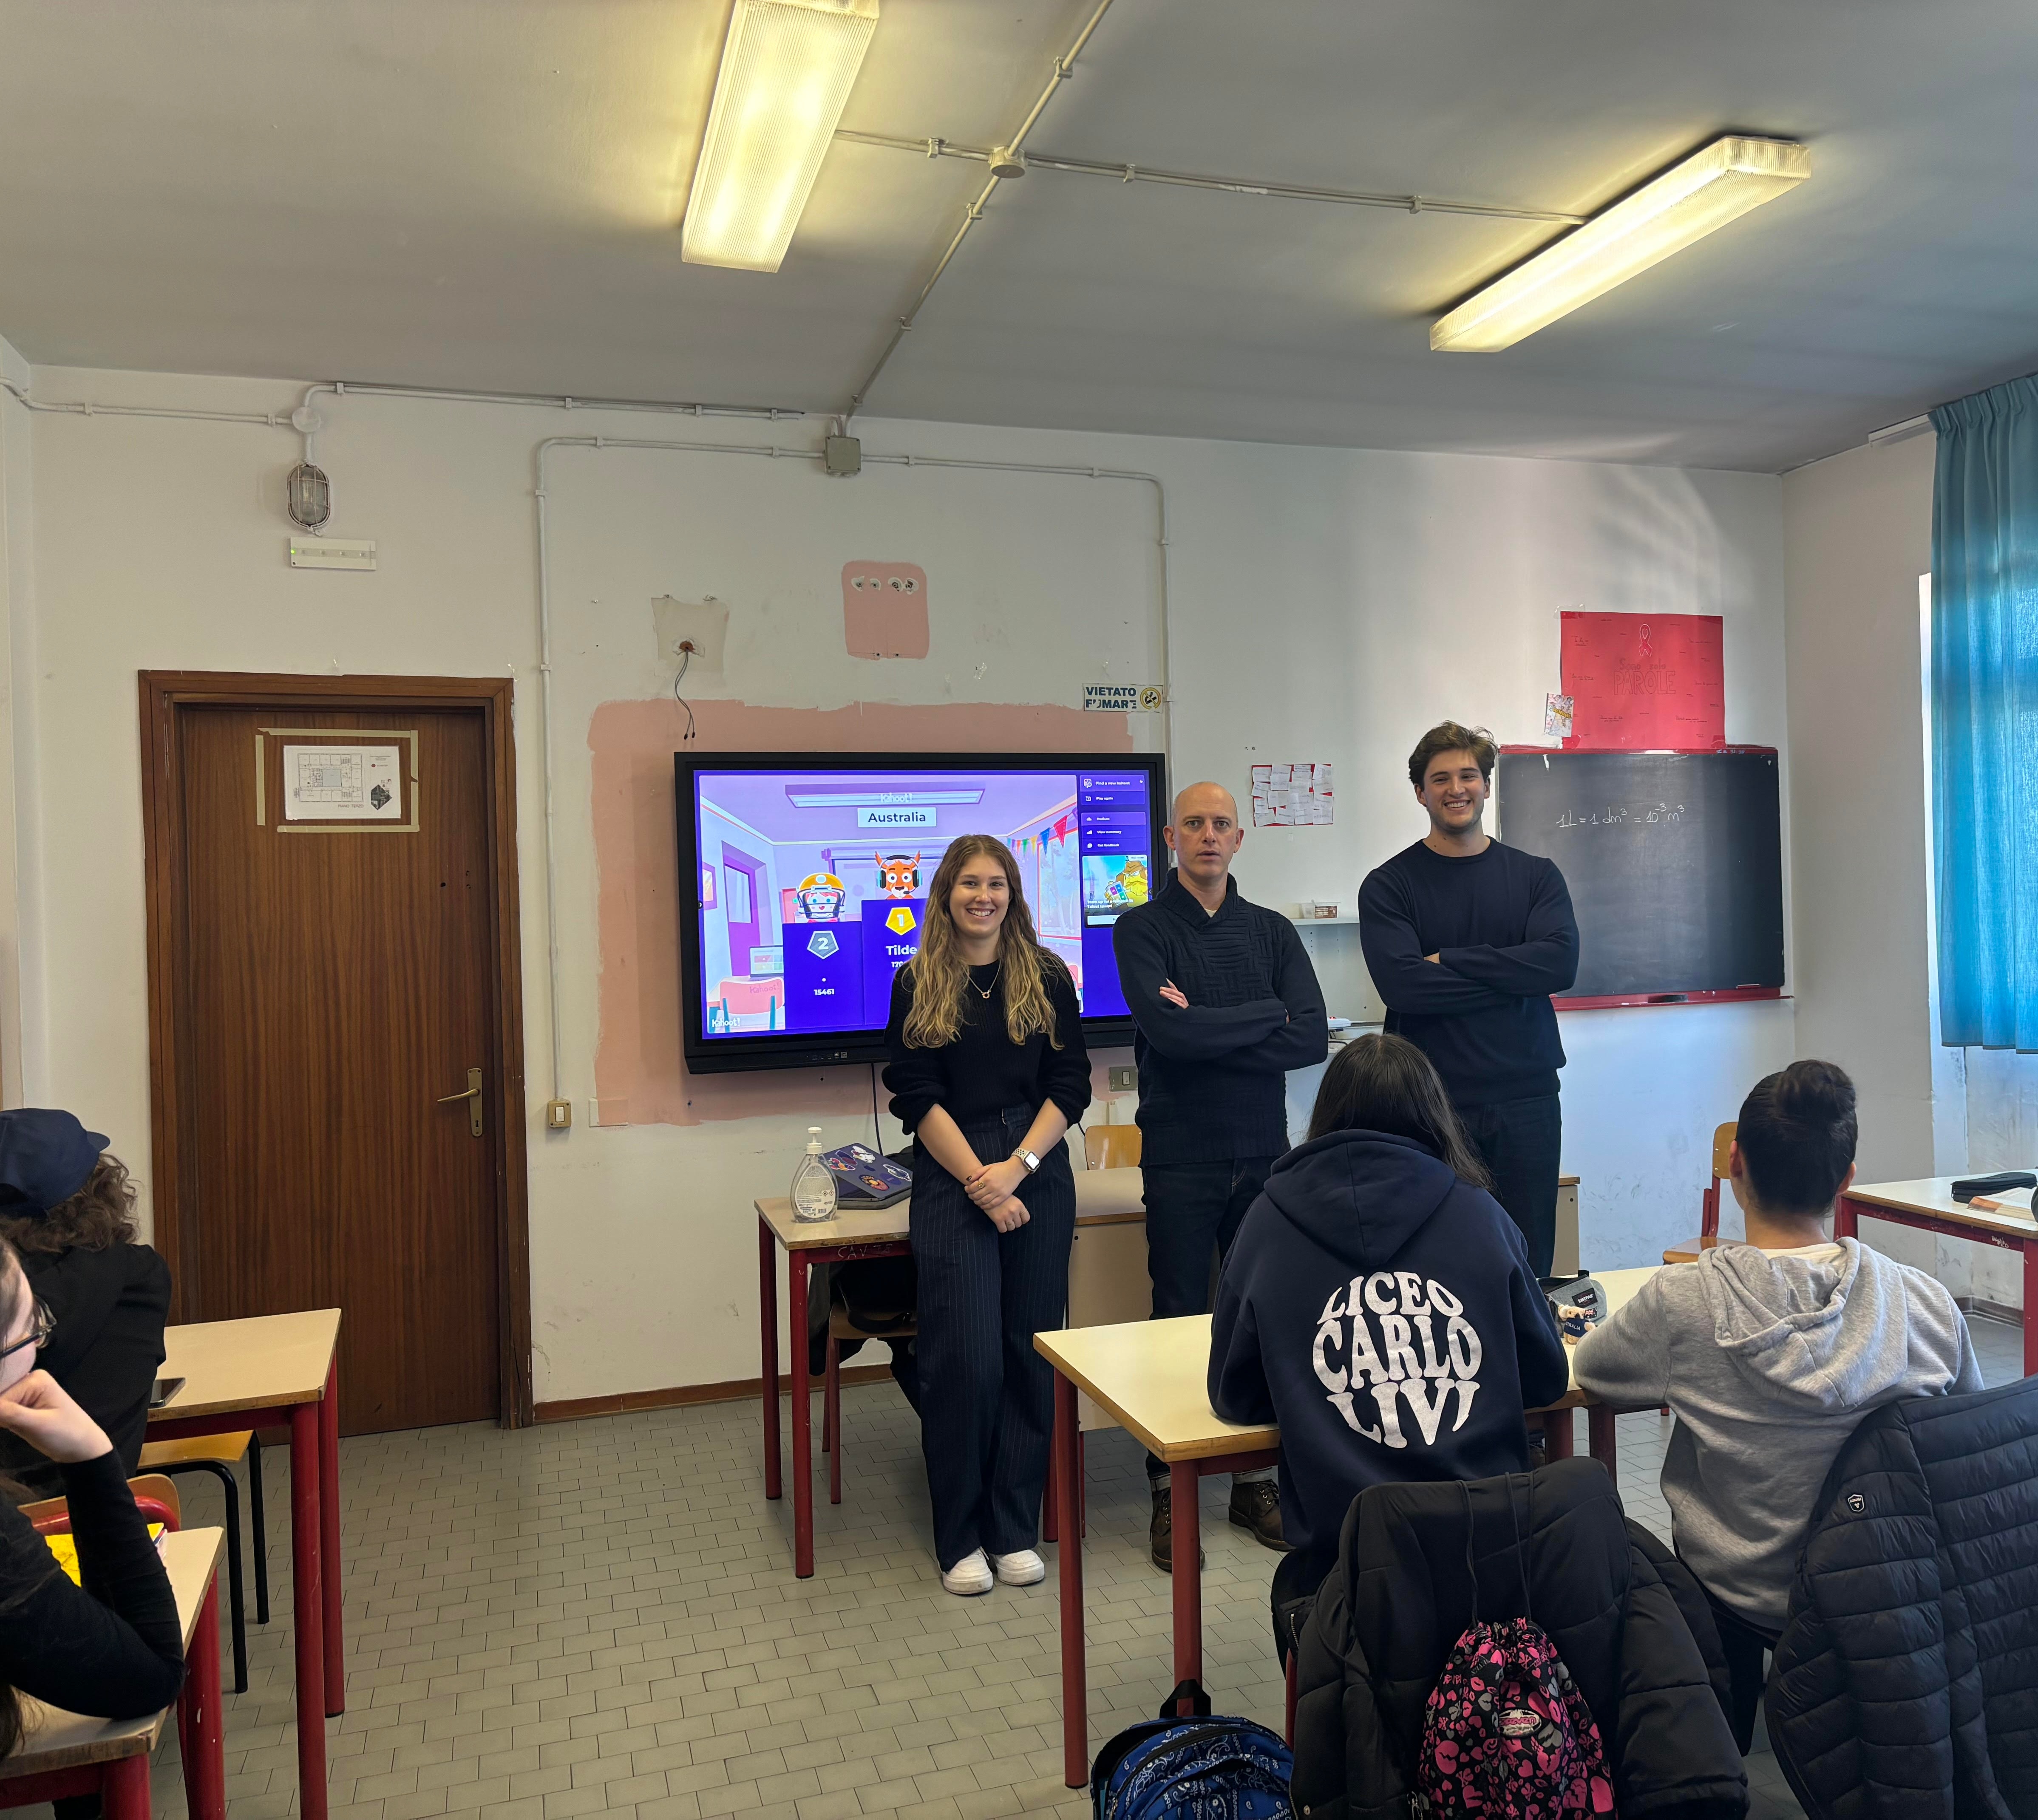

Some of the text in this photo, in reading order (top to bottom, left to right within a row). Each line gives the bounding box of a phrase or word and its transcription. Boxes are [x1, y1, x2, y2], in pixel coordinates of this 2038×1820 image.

[1619, 657, 1666, 671] Sono solo
[1614, 671, 1676, 695] PAROLE
[1086, 687, 1136, 696] VIETATO
[880, 793, 912, 803] Kahoot!
[868, 812, 926, 822] Australia
[1556, 810, 1577, 827] 1L
[1590, 814, 1599, 824] 1
[897, 914, 904, 927] 1
[818, 937, 829, 950] 2
[885, 945, 918, 955] Tilde
[750, 982, 779, 993] Kahoot!
[712, 1018, 740, 1027] Kahoot!
[1317, 1271, 1463, 1325] LICEO
[1313, 1314, 1482, 1393] CARLO
[1327, 1378, 1480, 1448] LIVI
